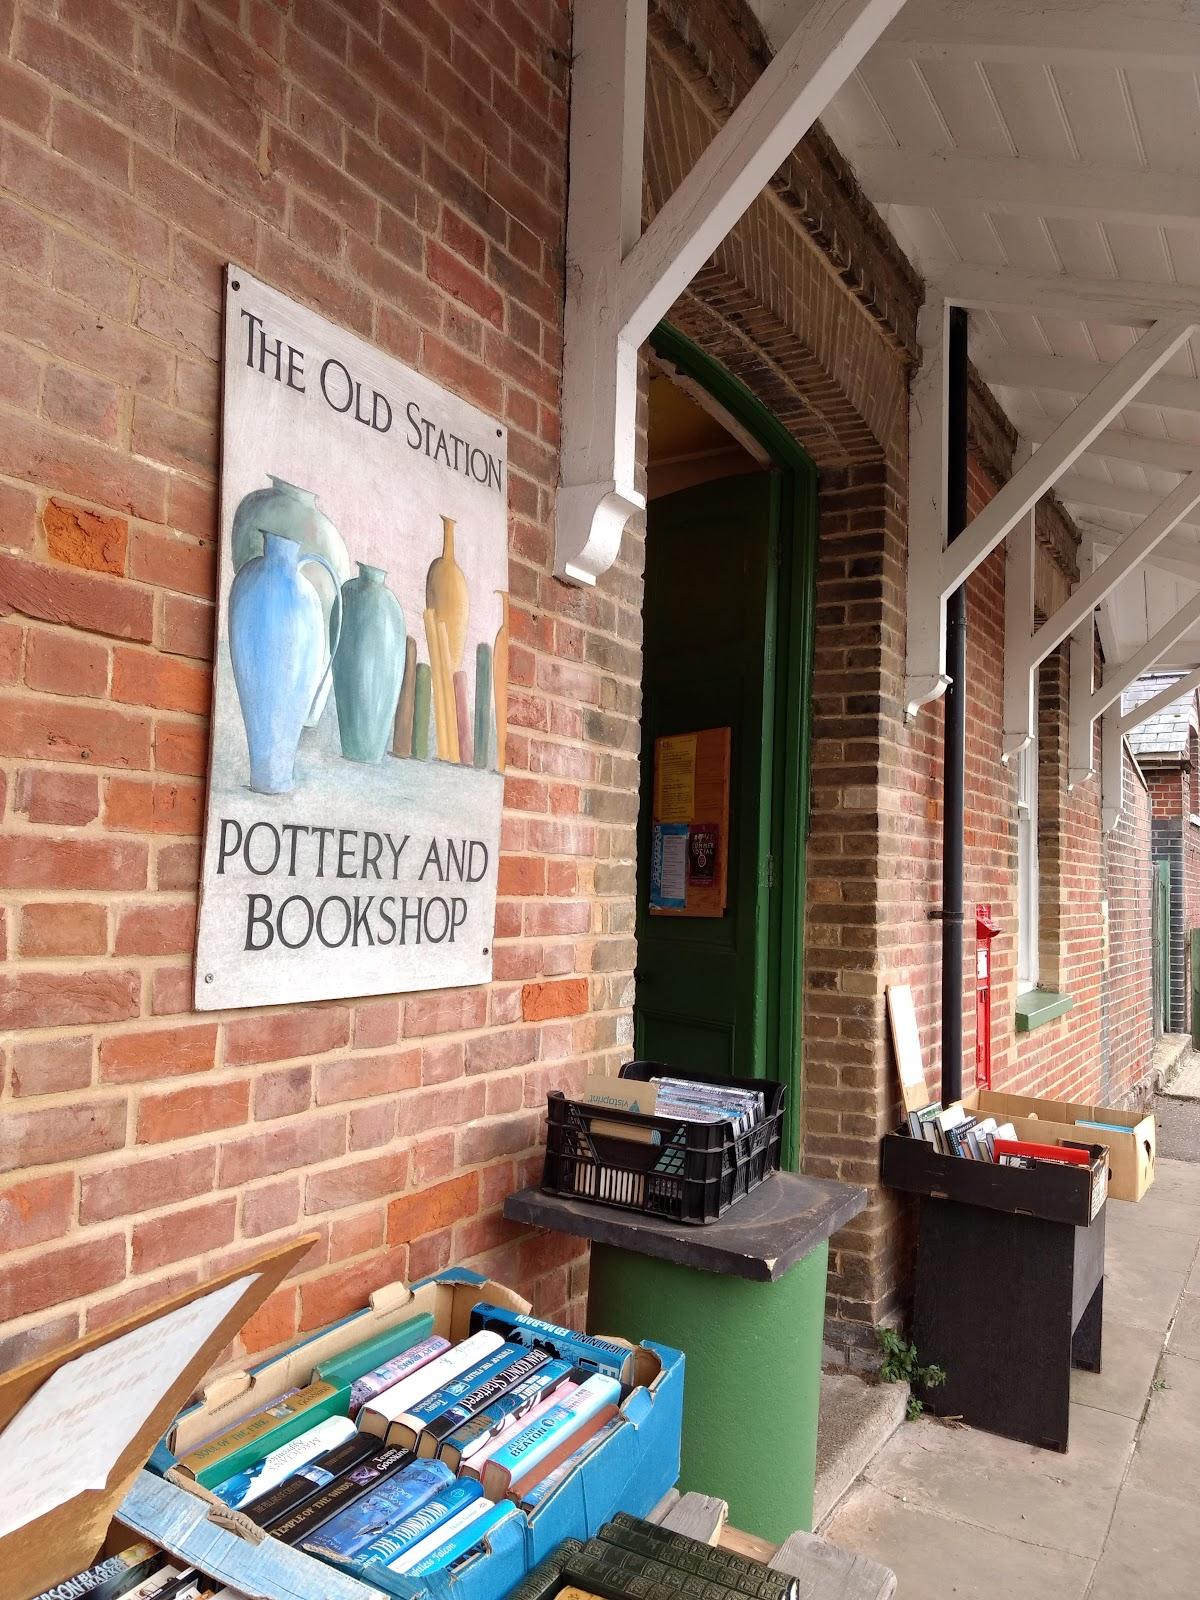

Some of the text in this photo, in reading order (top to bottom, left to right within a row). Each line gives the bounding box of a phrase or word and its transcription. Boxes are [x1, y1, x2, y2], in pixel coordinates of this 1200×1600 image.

[241, 308, 503, 493] THE OLD STATION
[216, 818, 489, 883] POTTERY AND
[243, 893, 468, 951] BOOKSHOP
[515, 1314, 628, 1356] LIGHTNING ED McBAIN
[500, 1357, 533, 1383] KOONTZ
[525, 1350, 548, 1367] DEAN
[459, 1376, 507, 1412] Shattered
[507, 1426, 538, 1452] ALISTAIR
[510, 1427, 548, 1457] BEATON
[269, 1481, 354, 1538] TEMPLE OF THE WINDS
[368, 1535, 401, 1559] THE
[387, 1501, 448, 1545] FOUNDATION
[78, 1553, 121, 1583] BLACK
[431, 1542, 457, 1561] Falcon
[32, 1576, 85, 1600] RSON
